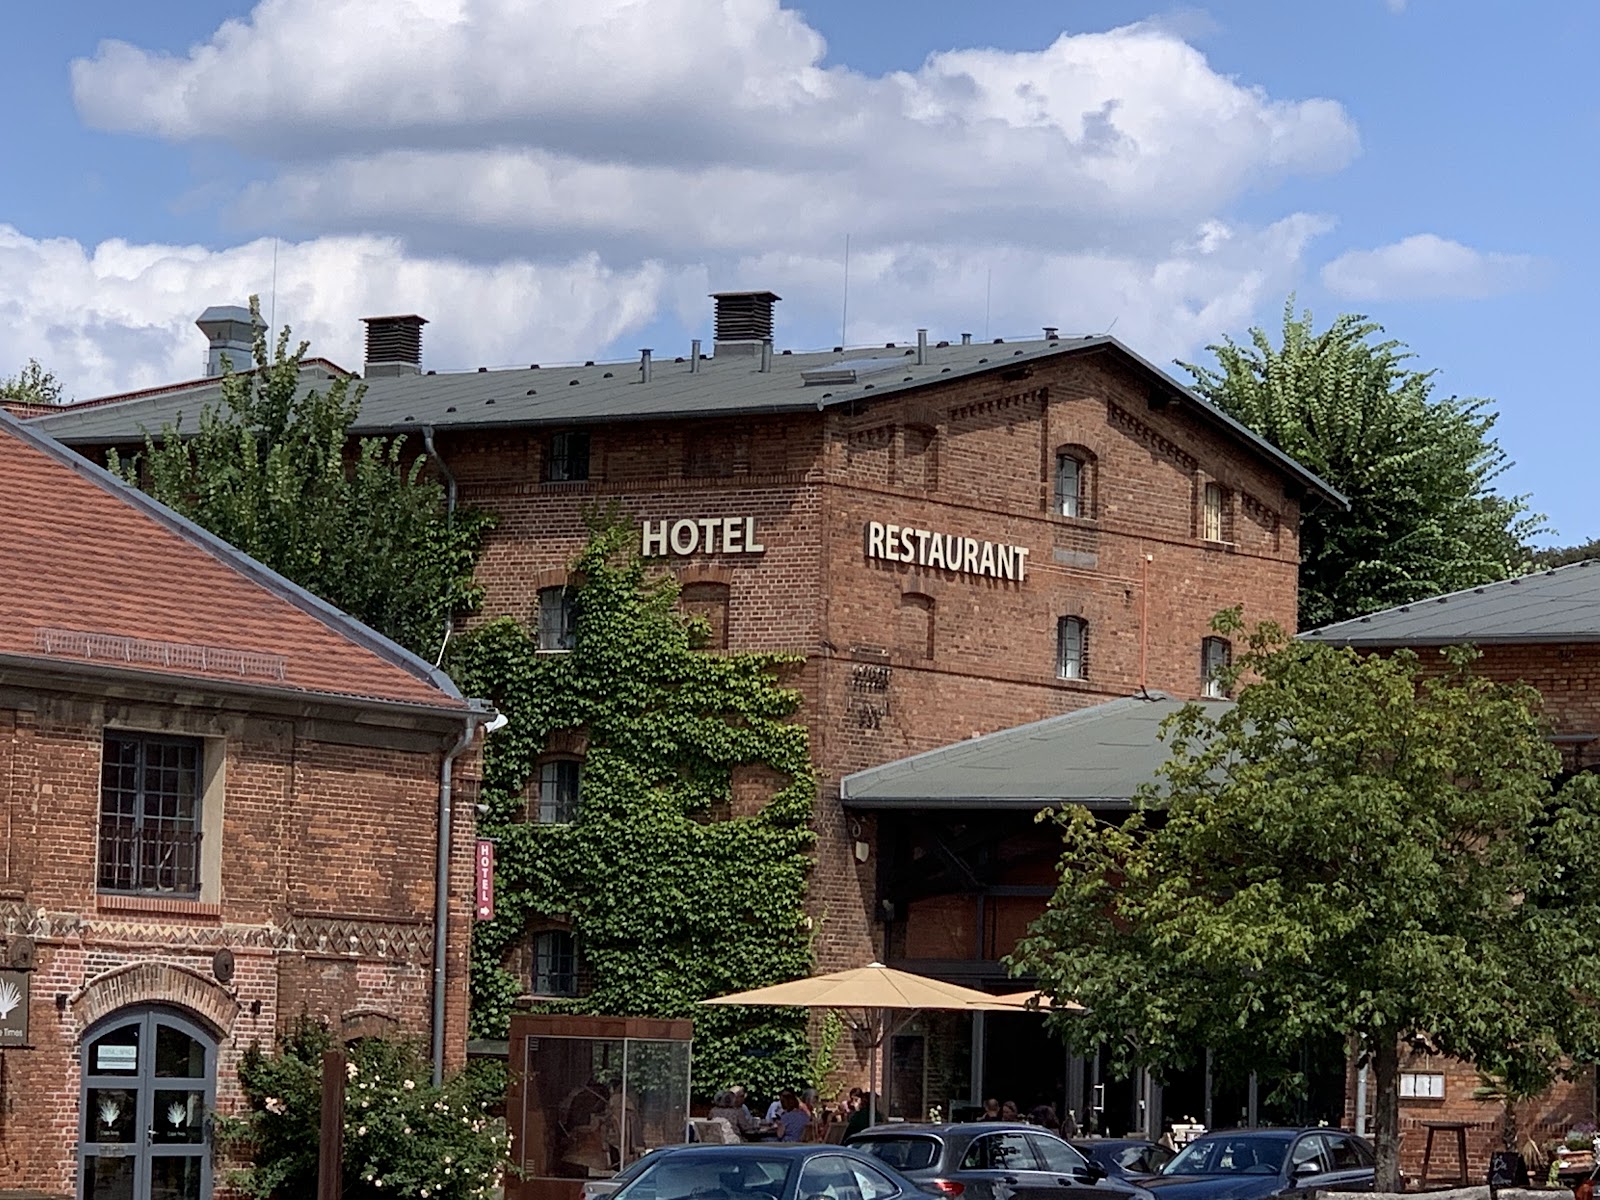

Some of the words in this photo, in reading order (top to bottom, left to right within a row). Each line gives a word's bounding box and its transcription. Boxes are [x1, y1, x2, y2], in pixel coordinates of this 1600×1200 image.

[642, 516, 764, 556] HOTEL
[867, 520, 1030, 582] RESTAURANT
[481, 844, 490, 902] HOTEL
